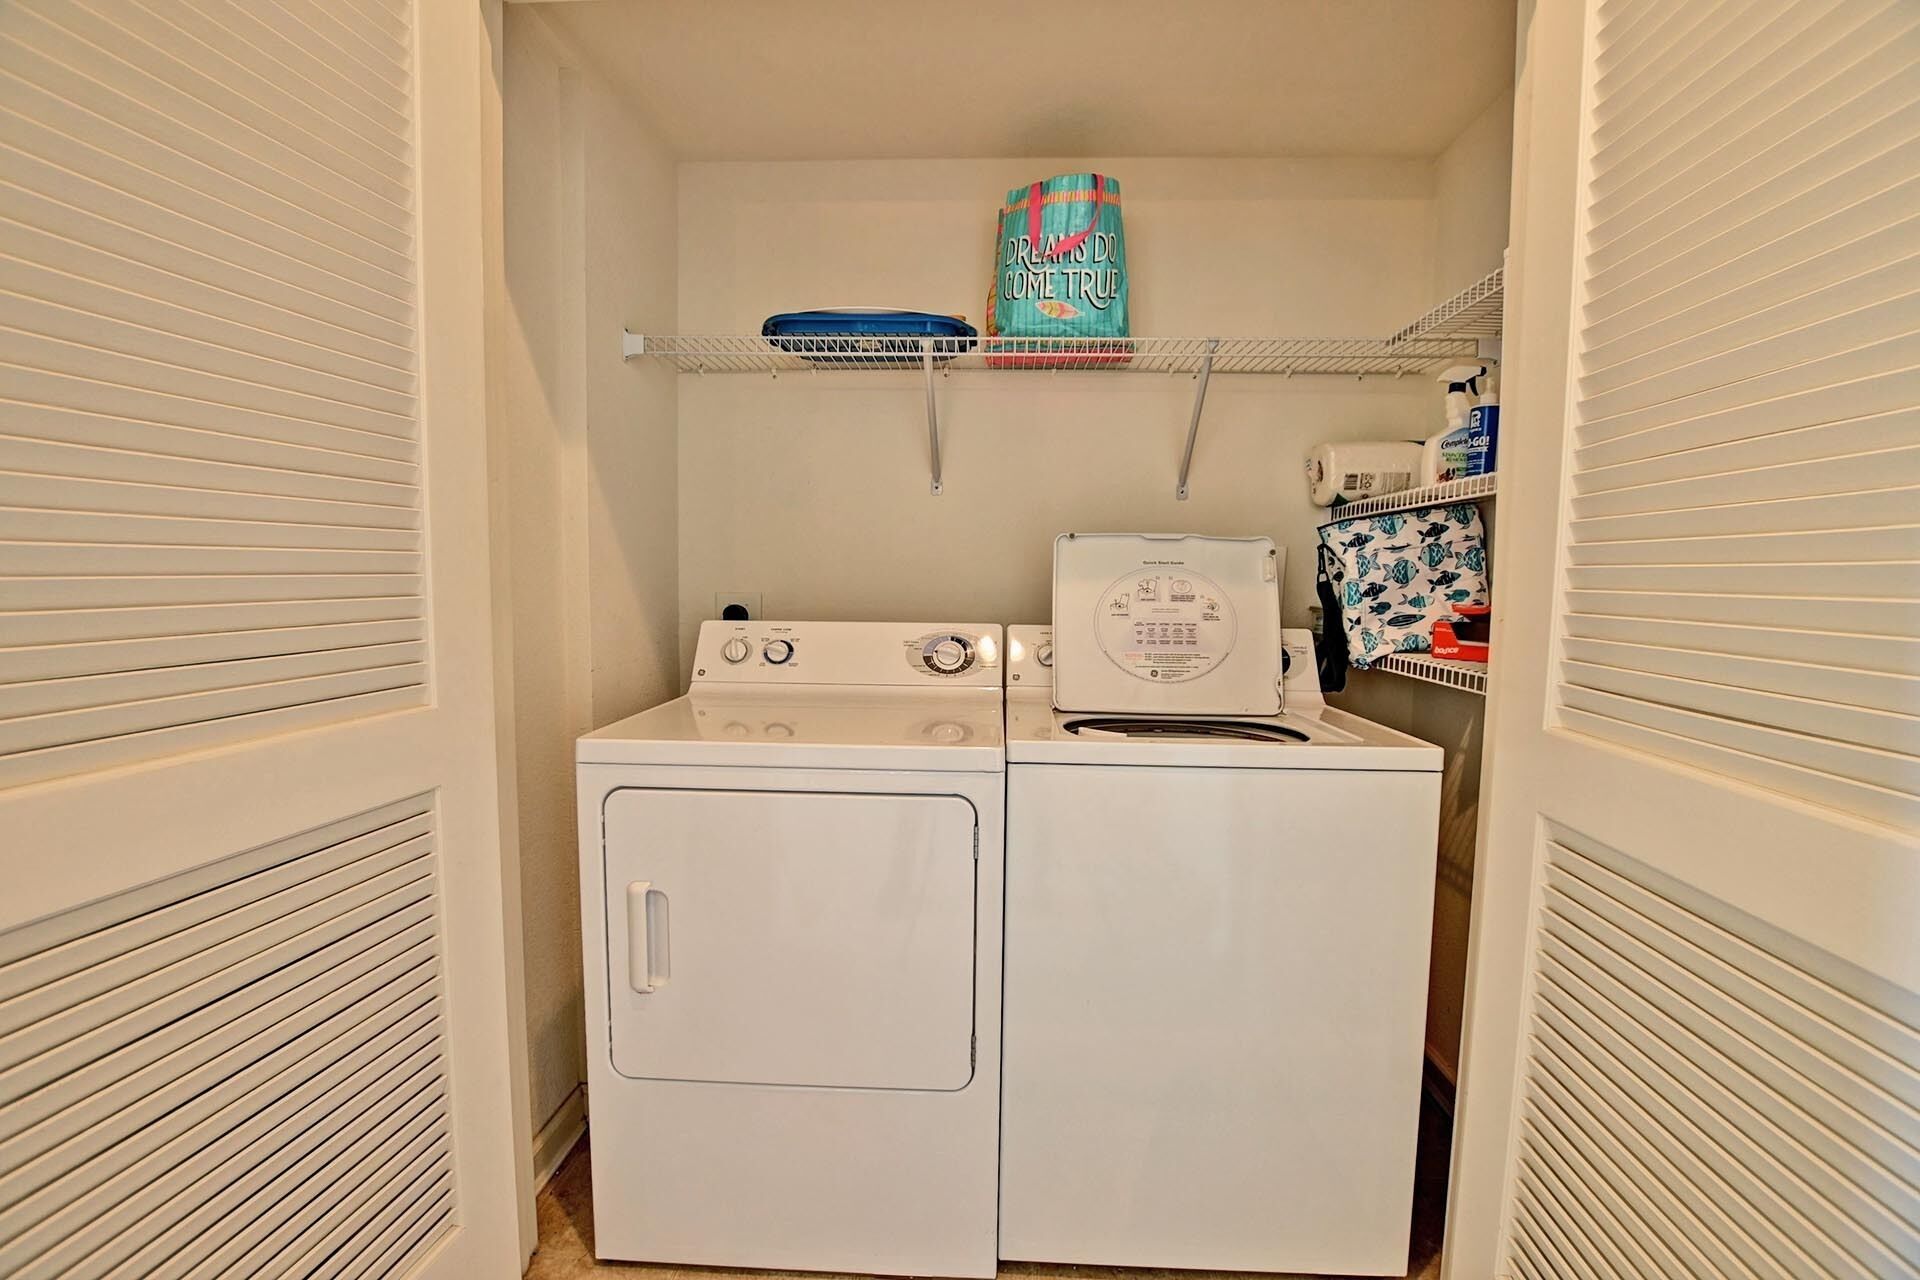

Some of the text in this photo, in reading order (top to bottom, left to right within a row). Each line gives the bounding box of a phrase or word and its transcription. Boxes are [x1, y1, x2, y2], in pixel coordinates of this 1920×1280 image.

[1092, 231, 1117, 264] DO
[1003, 267, 1120, 310] COME TRUE
